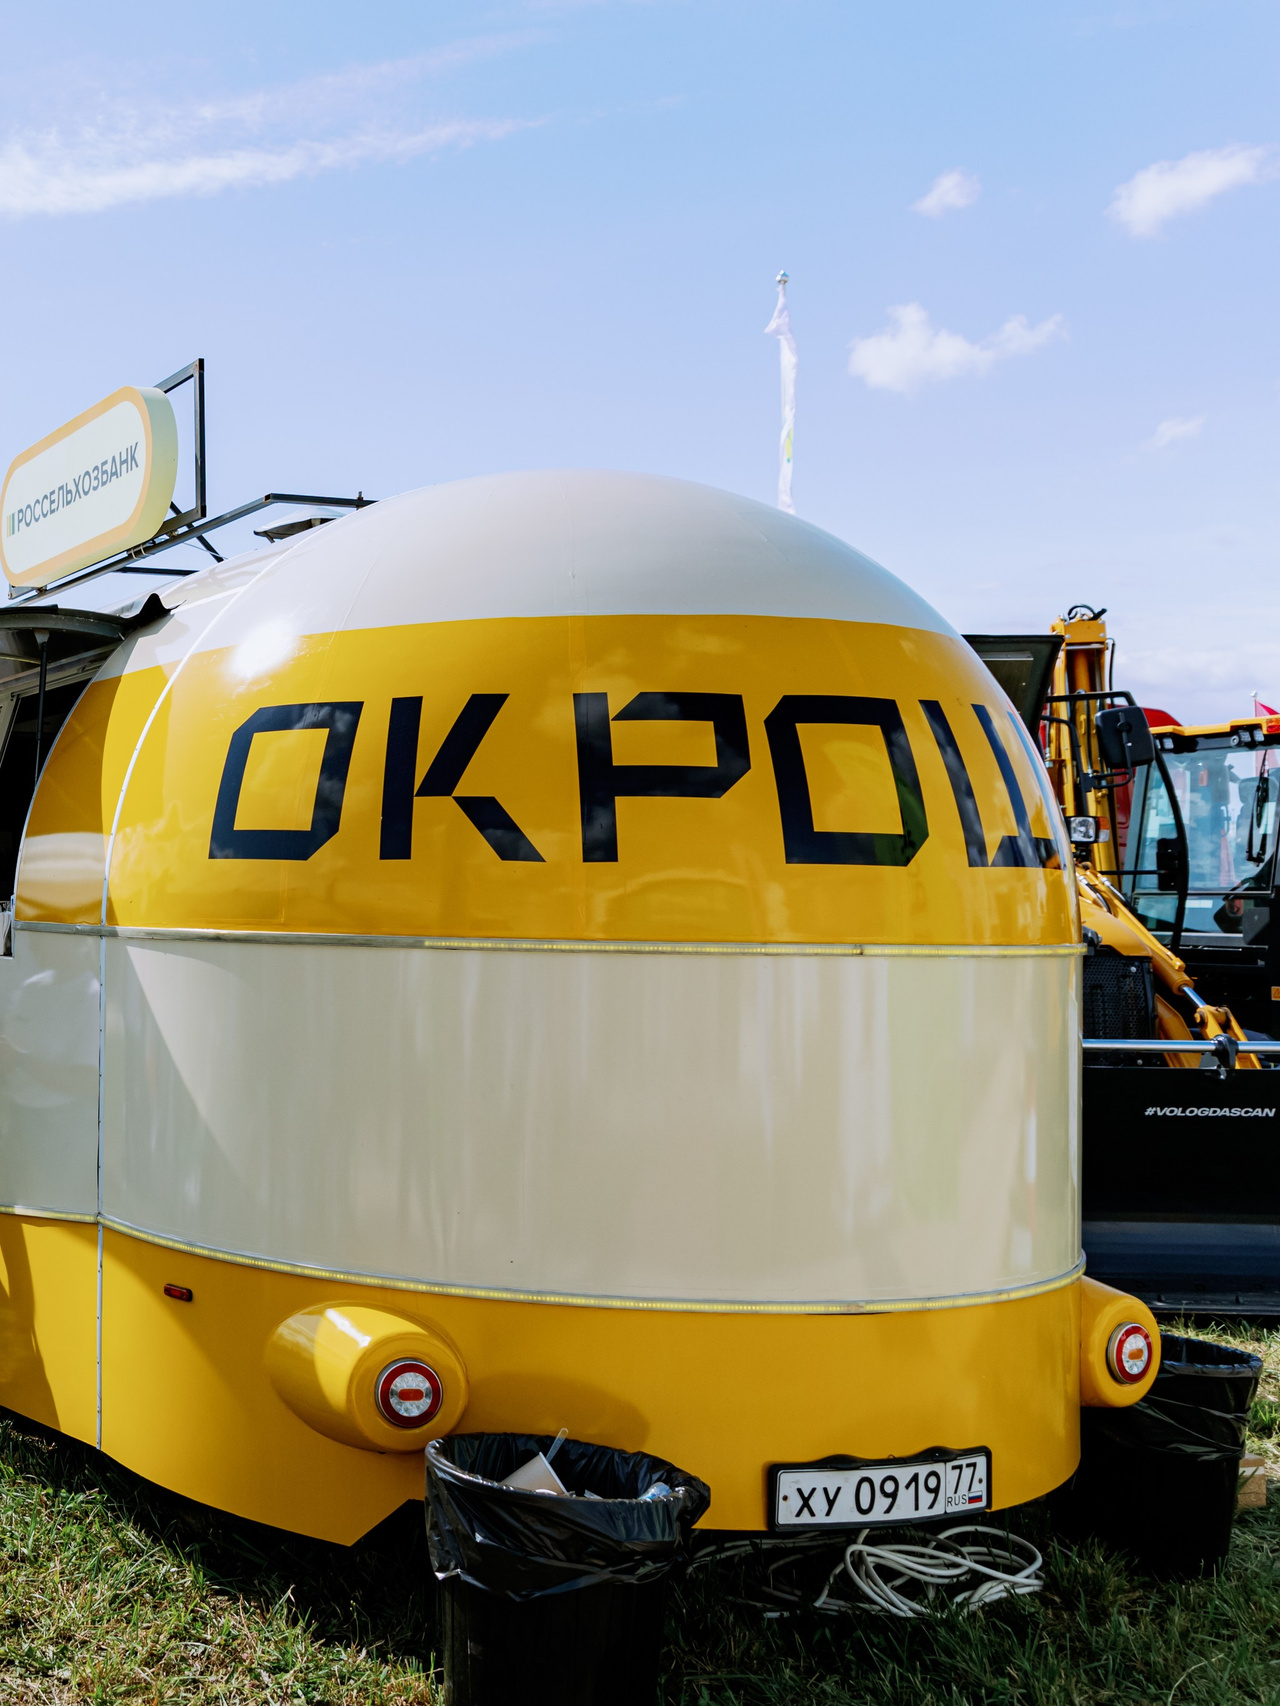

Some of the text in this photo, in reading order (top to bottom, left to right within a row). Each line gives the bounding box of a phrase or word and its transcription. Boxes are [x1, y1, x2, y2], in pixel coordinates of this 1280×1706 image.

[17, 441, 139, 532] РОССЕЛЬХОЗБАНК
[1144, 1106, 1276, 1117] #VOLOGDASCAN
[854, 1470, 941, 1515] 0919
[951, 1462, 978, 1494] 77
[946, 1494, 968, 1507] RUS
